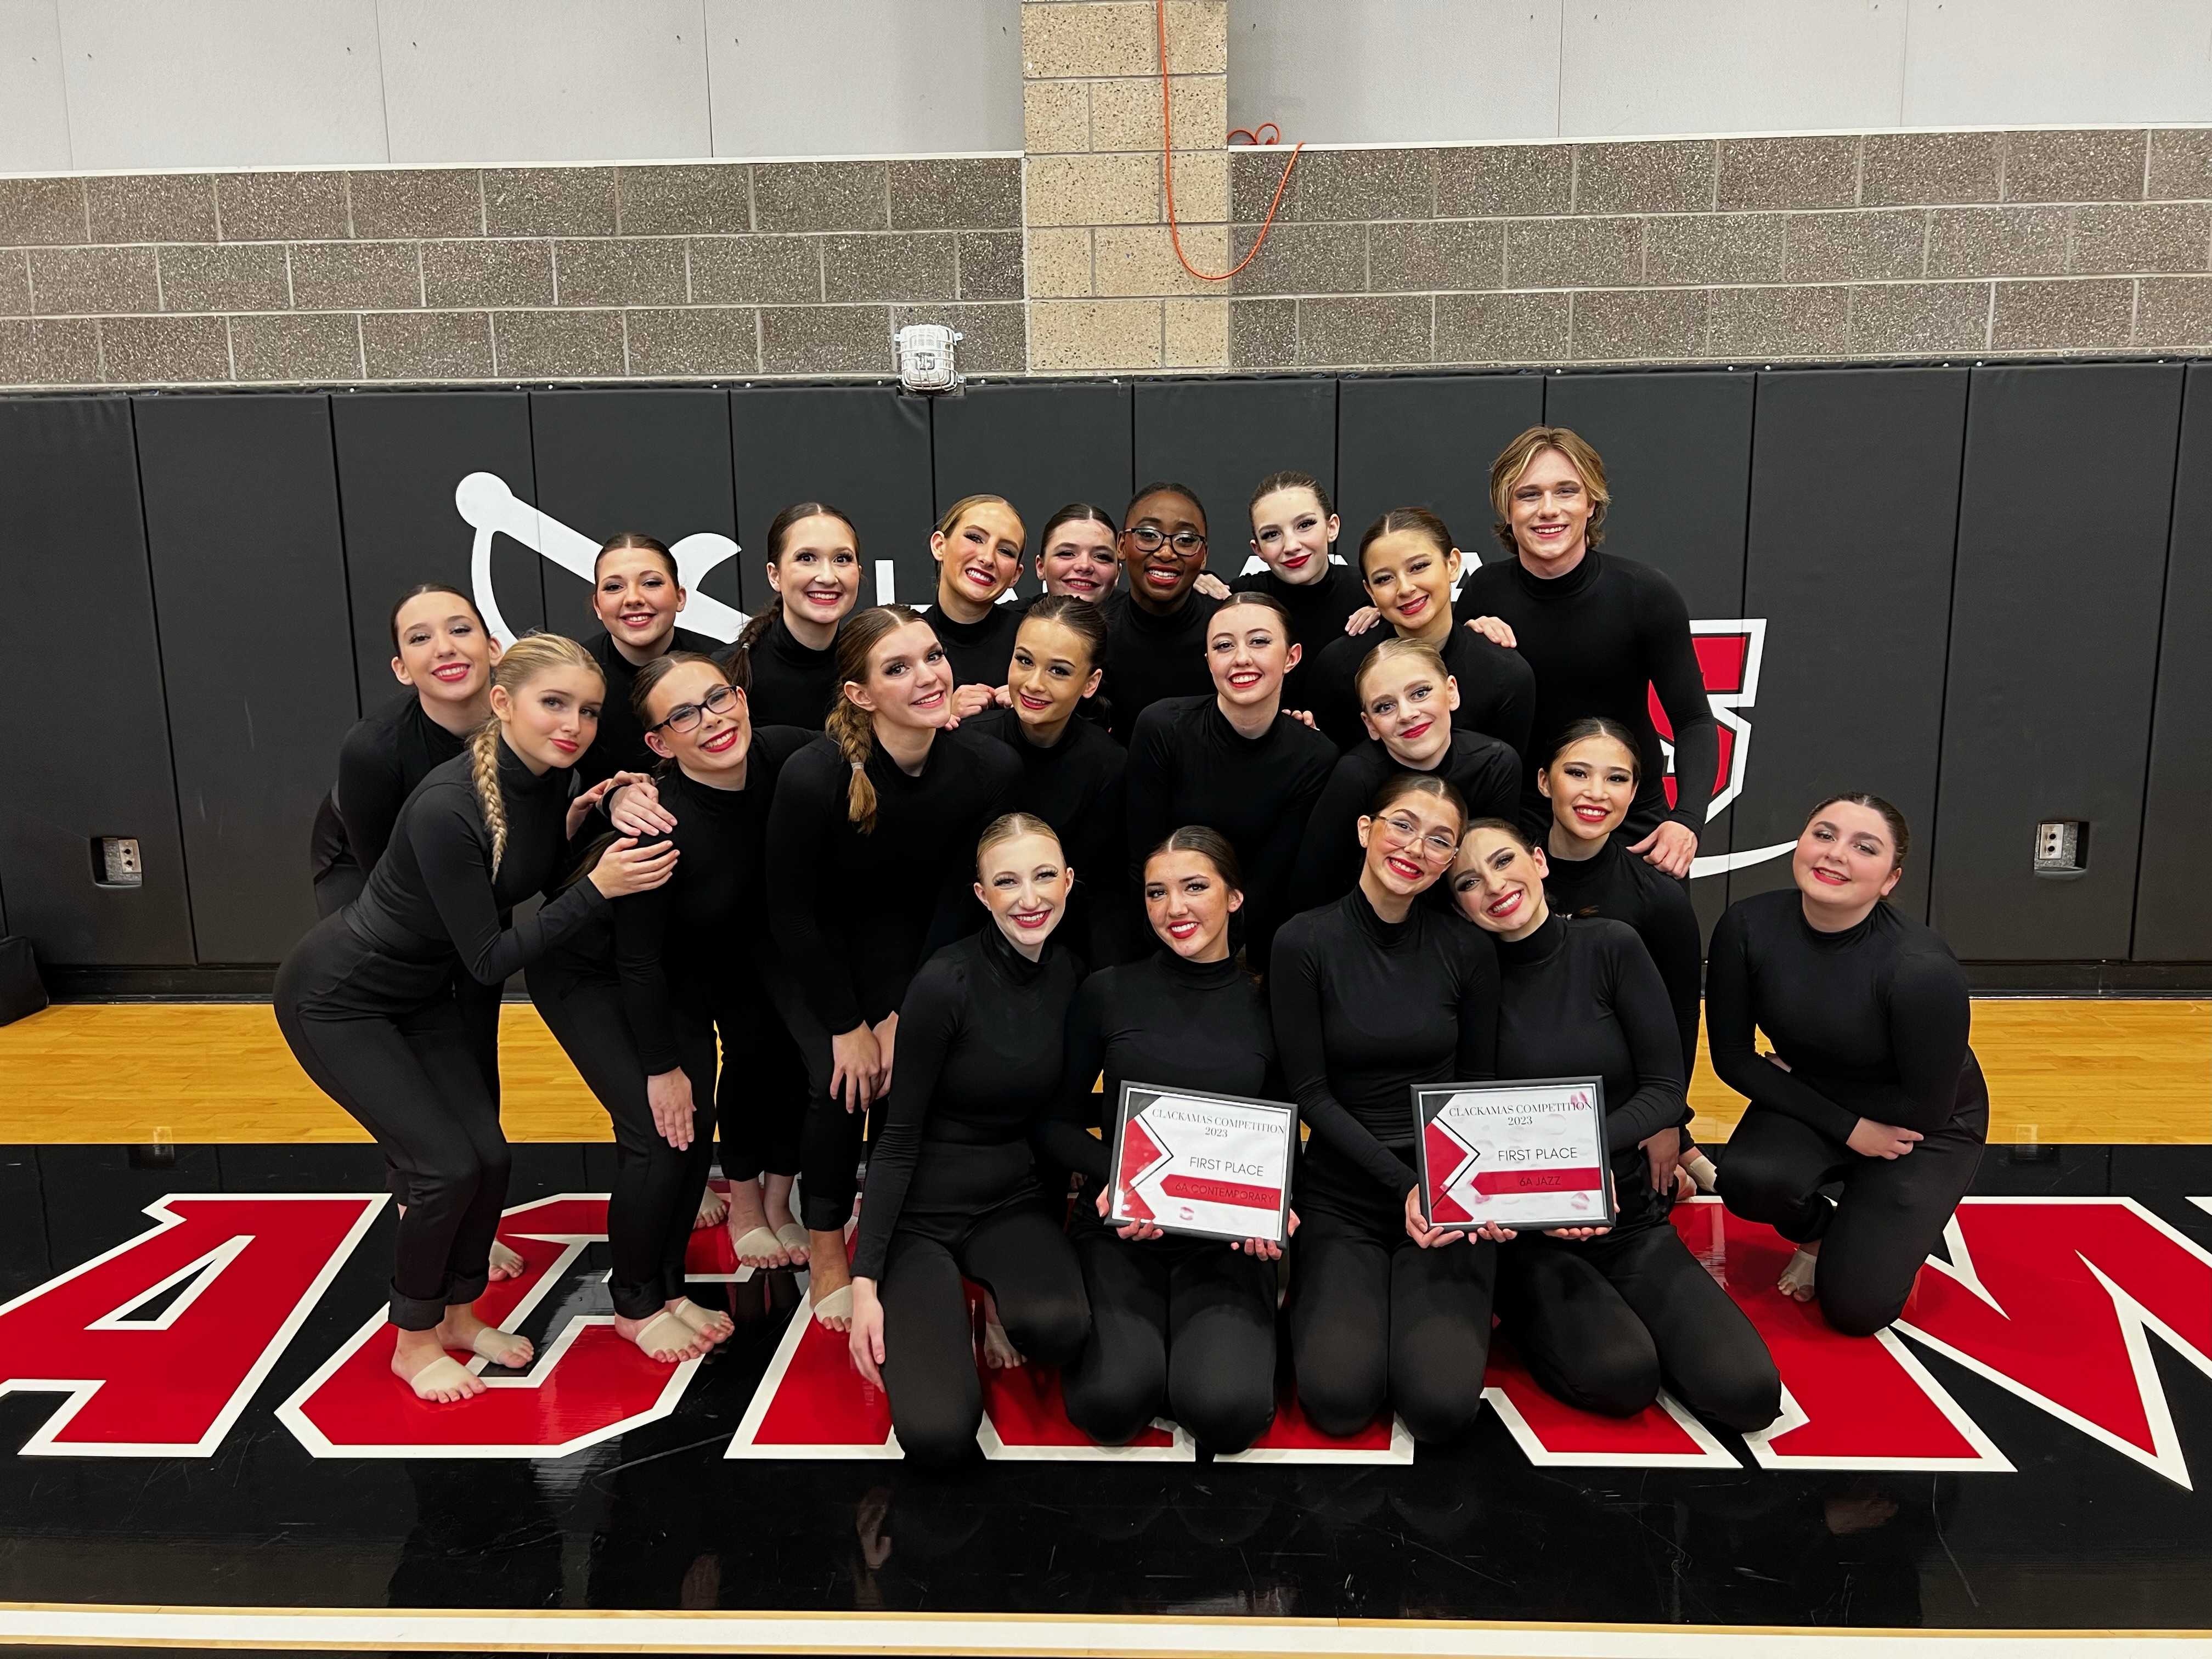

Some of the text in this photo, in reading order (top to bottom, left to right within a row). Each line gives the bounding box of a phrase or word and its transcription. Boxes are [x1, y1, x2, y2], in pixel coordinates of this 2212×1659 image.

[1448, 1102, 1593, 1117] CLACKAMAS COMPETITION
[1152, 1108, 1285, 1134] CLACKAMAS COMPETITION
[1508, 1116, 1533, 1126] 2023
[1204, 1126, 1228, 1137] 2023
[1498, 1147, 1577, 1161] FIRST PLACE
[1189, 1156, 1264, 1177] FIRST PLACE
[1519, 1176, 1561, 1187] 6A JAZZ
[1175, 1182, 1274, 1203] 6A CONTEMPORARY
